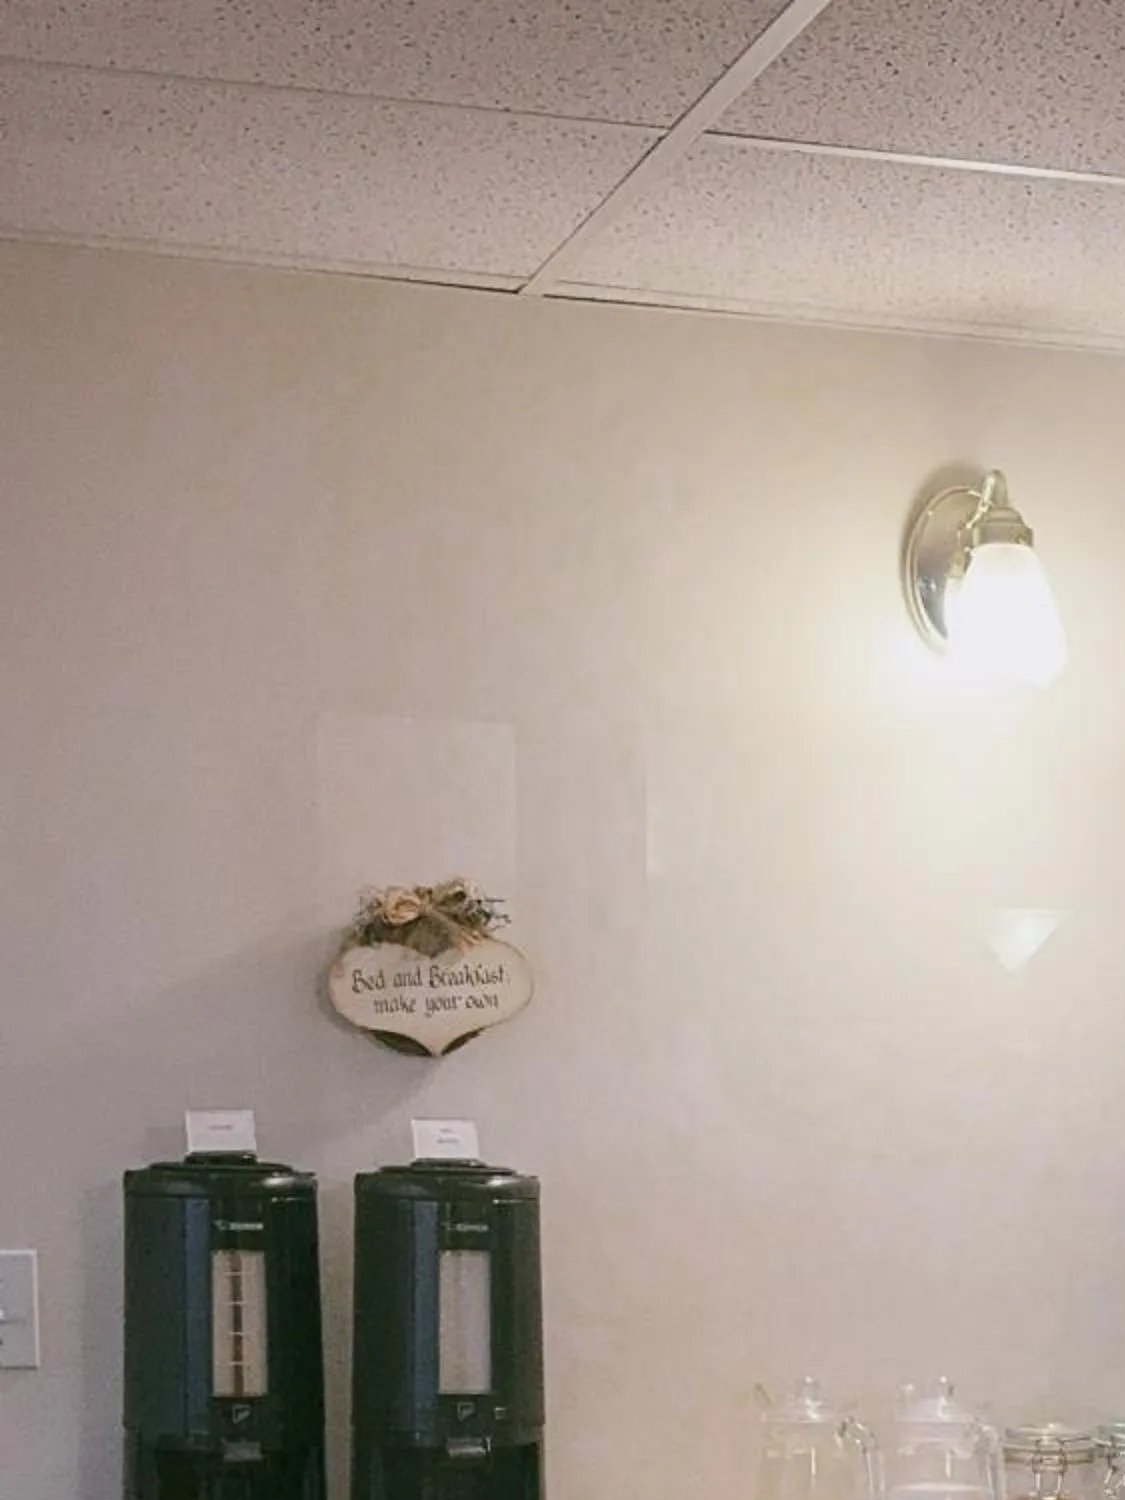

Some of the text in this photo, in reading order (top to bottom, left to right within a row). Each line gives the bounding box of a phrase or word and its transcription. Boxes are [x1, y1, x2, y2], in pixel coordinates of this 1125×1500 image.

[351, 963, 505, 993] Bed and Breakfast
[373, 993, 500, 1018] make your own
